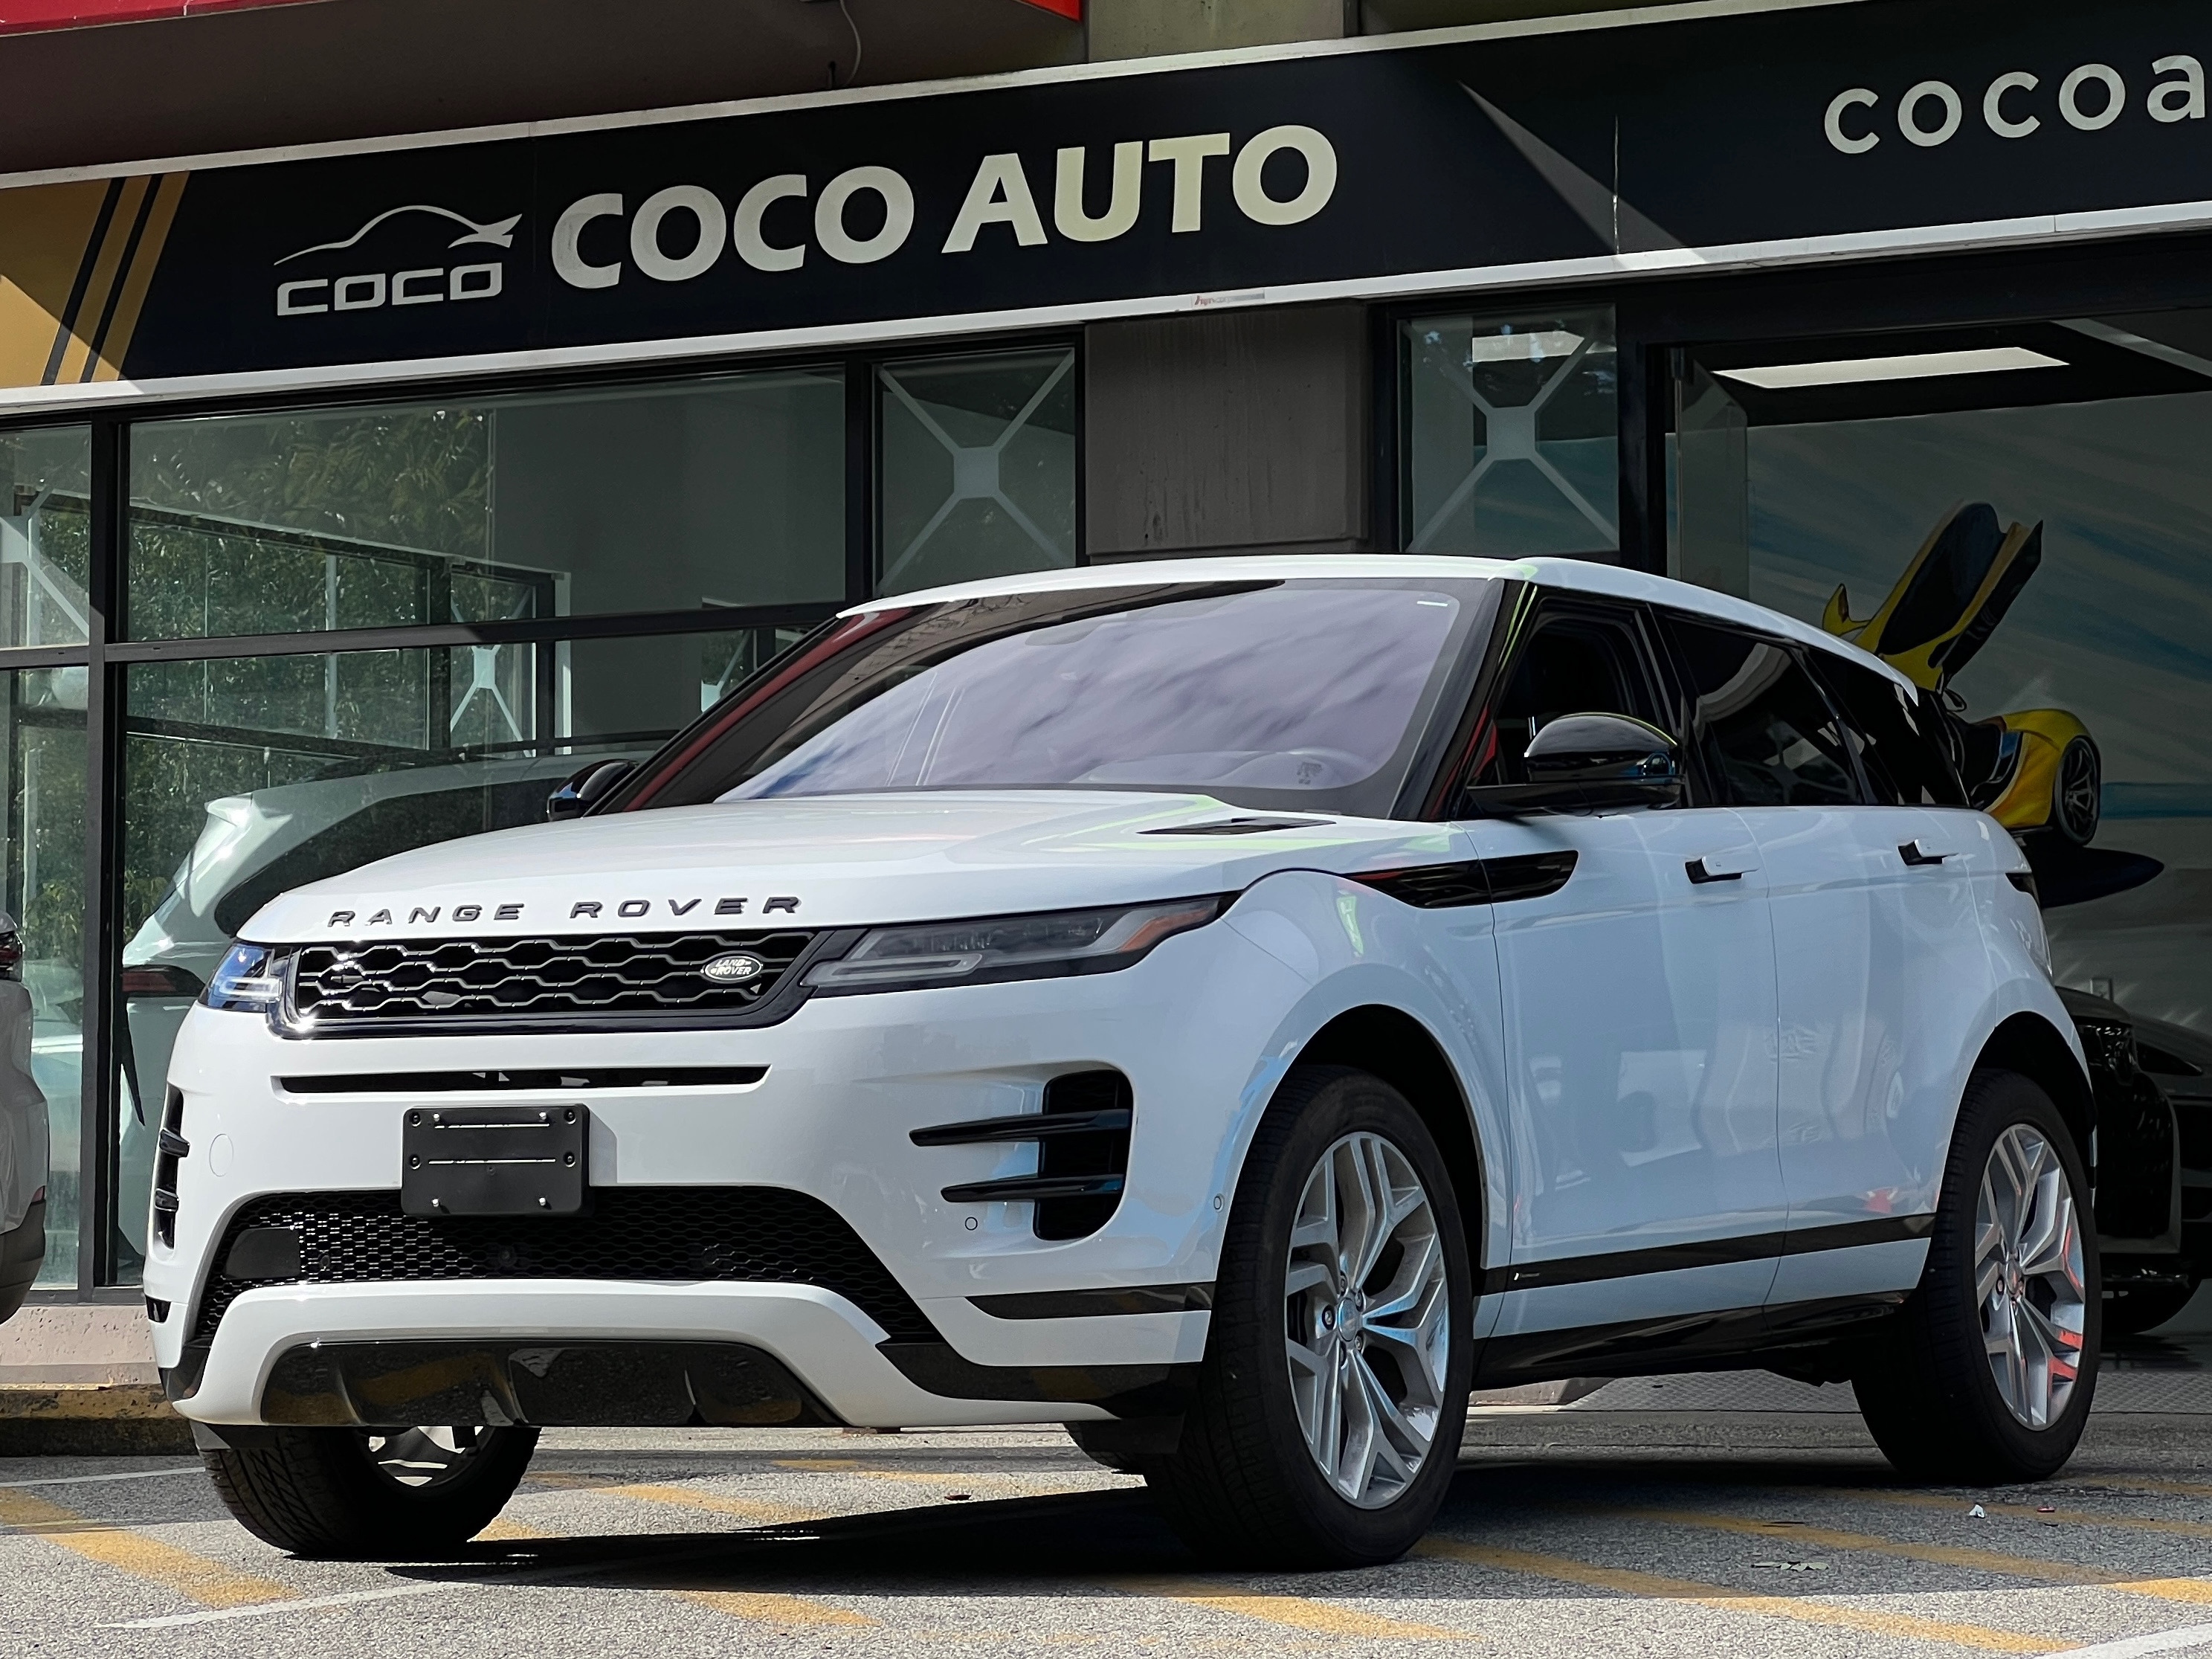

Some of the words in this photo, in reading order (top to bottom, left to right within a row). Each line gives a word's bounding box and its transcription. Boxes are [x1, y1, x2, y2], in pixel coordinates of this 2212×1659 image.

[1824, 54, 2205, 154] cocoa
[551, 166, 915, 289] COCO
[941, 124, 1338, 254] AUTO
[277, 262, 503, 316] COCO
[327, 903, 525, 927] RANGE
[569, 896, 802, 919] ROVER
